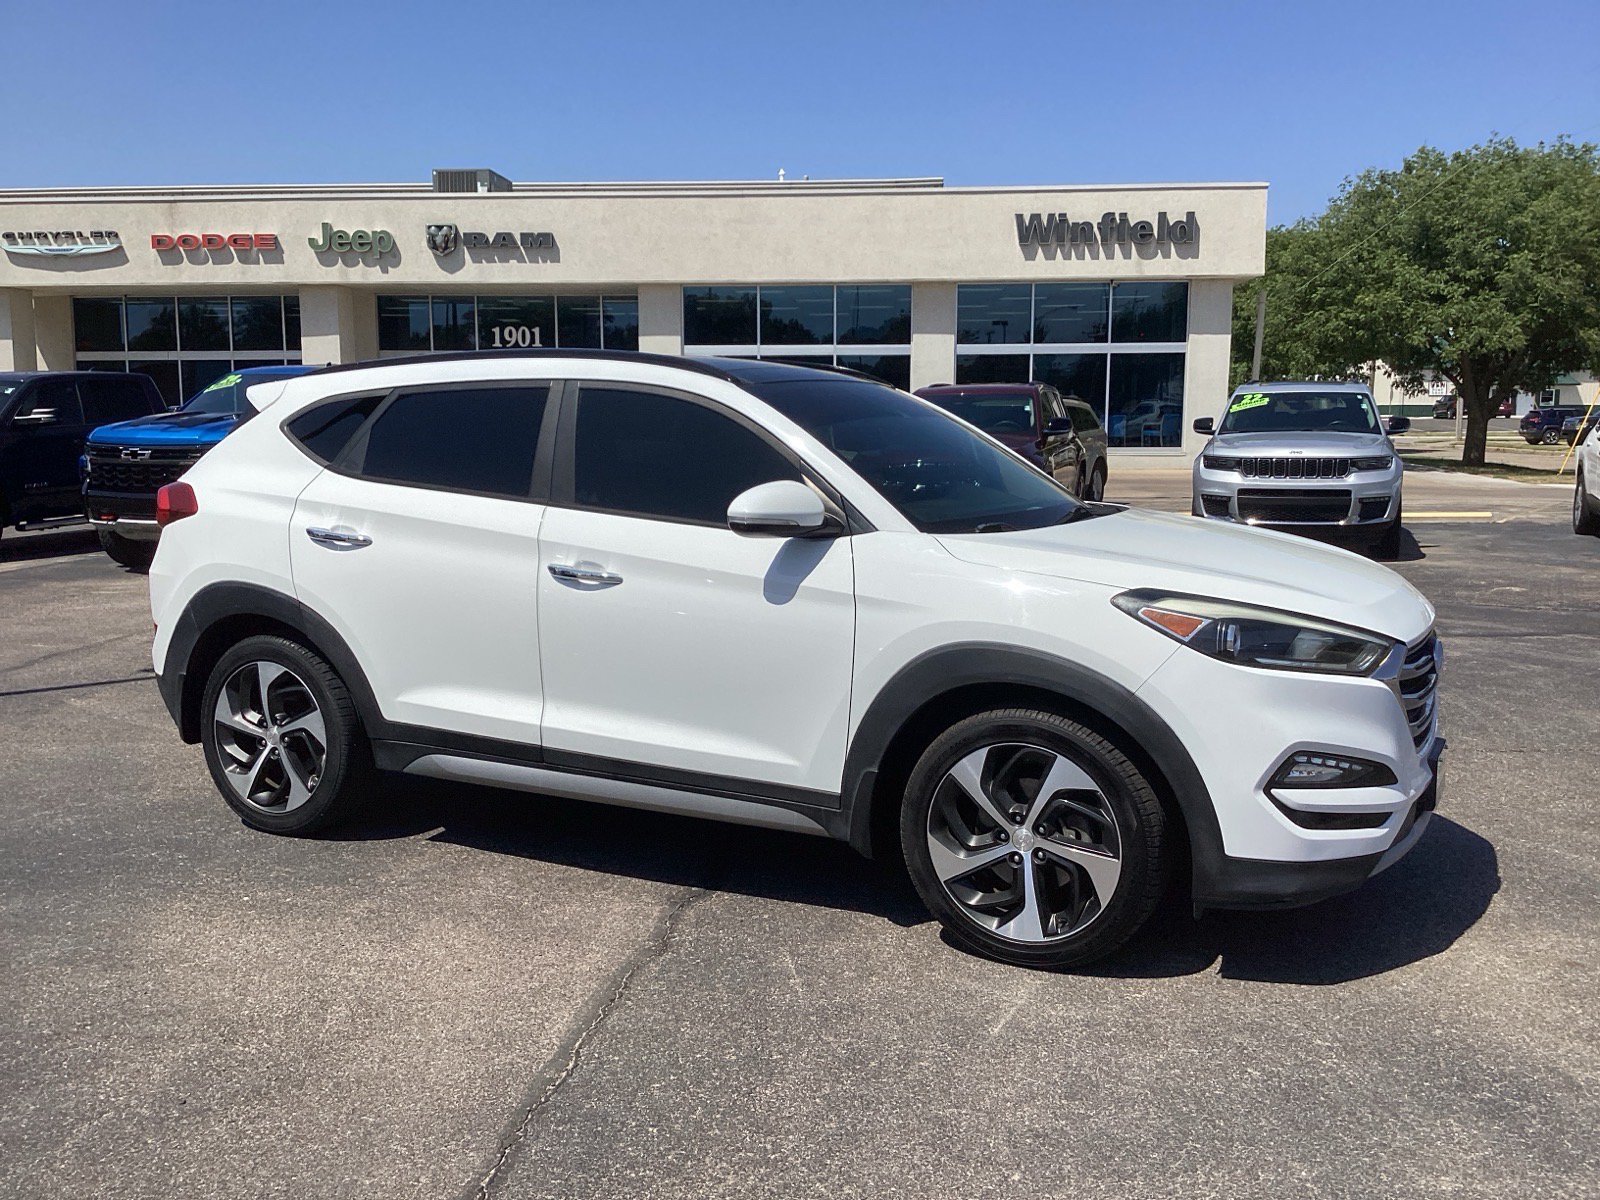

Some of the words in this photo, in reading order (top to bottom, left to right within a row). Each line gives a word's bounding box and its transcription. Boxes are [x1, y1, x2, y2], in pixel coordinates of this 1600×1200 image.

[2, 230, 119, 241] CHRYSLER
[1014, 211, 1196, 245] Winfield
[151, 233, 277, 250] DODGE
[307, 222, 394, 259] Jeep
[462, 231, 553, 248] RAM
[491, 326, 543, 348] 1901
[1241, 393, 1263, 405] 22
